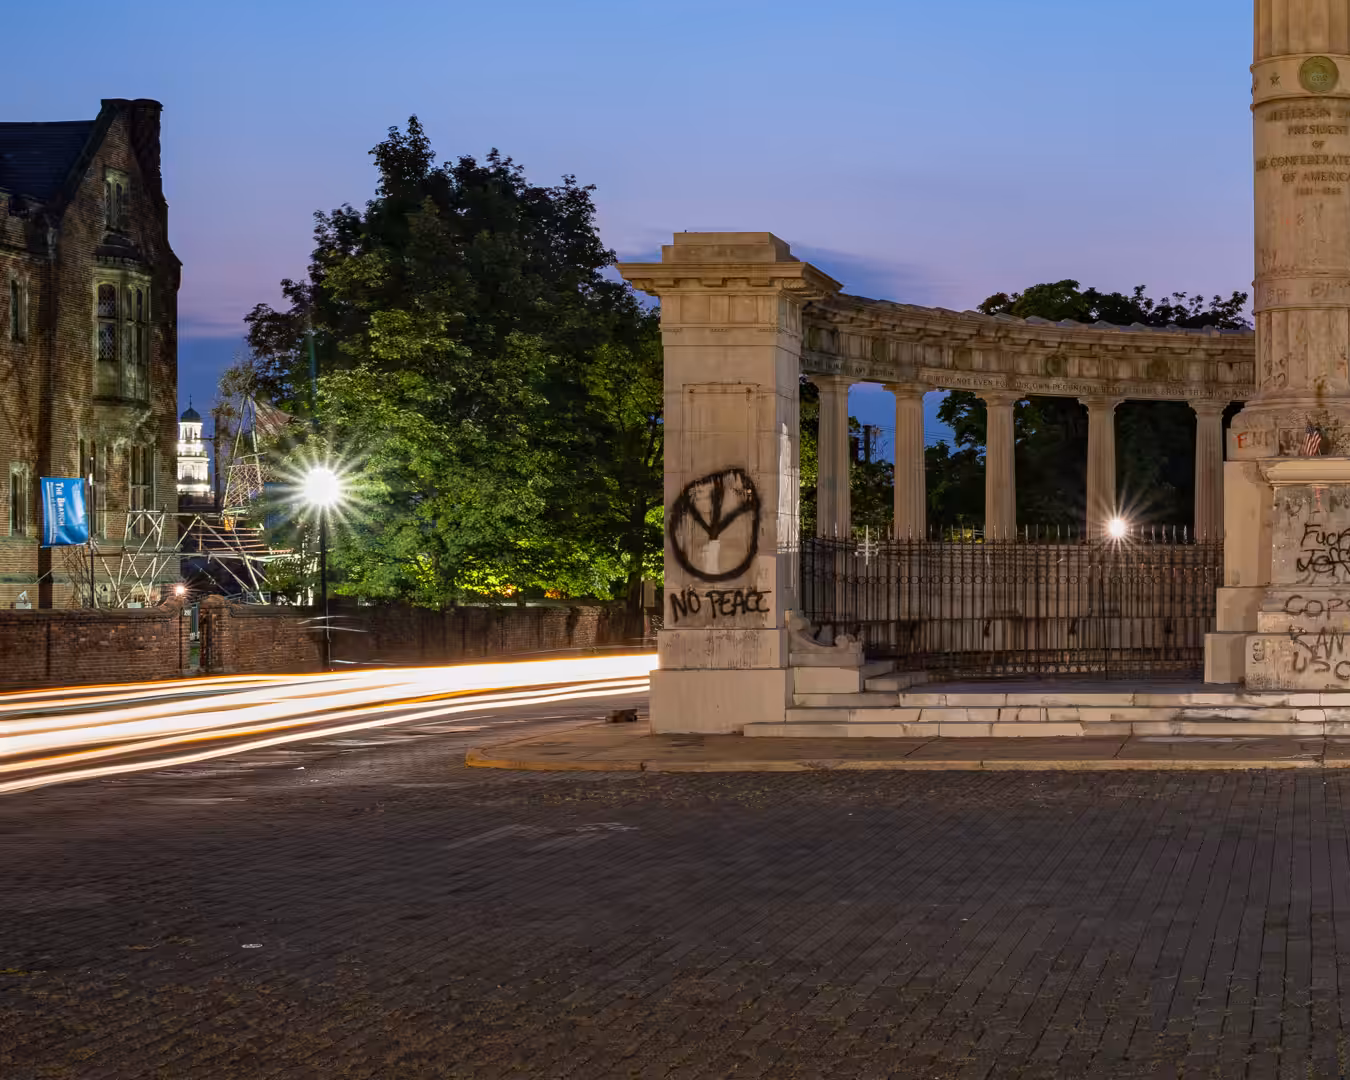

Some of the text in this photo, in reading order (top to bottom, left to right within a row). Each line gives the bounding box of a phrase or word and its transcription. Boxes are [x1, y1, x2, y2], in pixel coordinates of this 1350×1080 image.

[1287, 124, 1350, 136] PRESIDENT
[973, 378, 993, 387] EVEN
[55, 481, 65, 496] THE
[670, 587, 772, 622] NO PEACE
